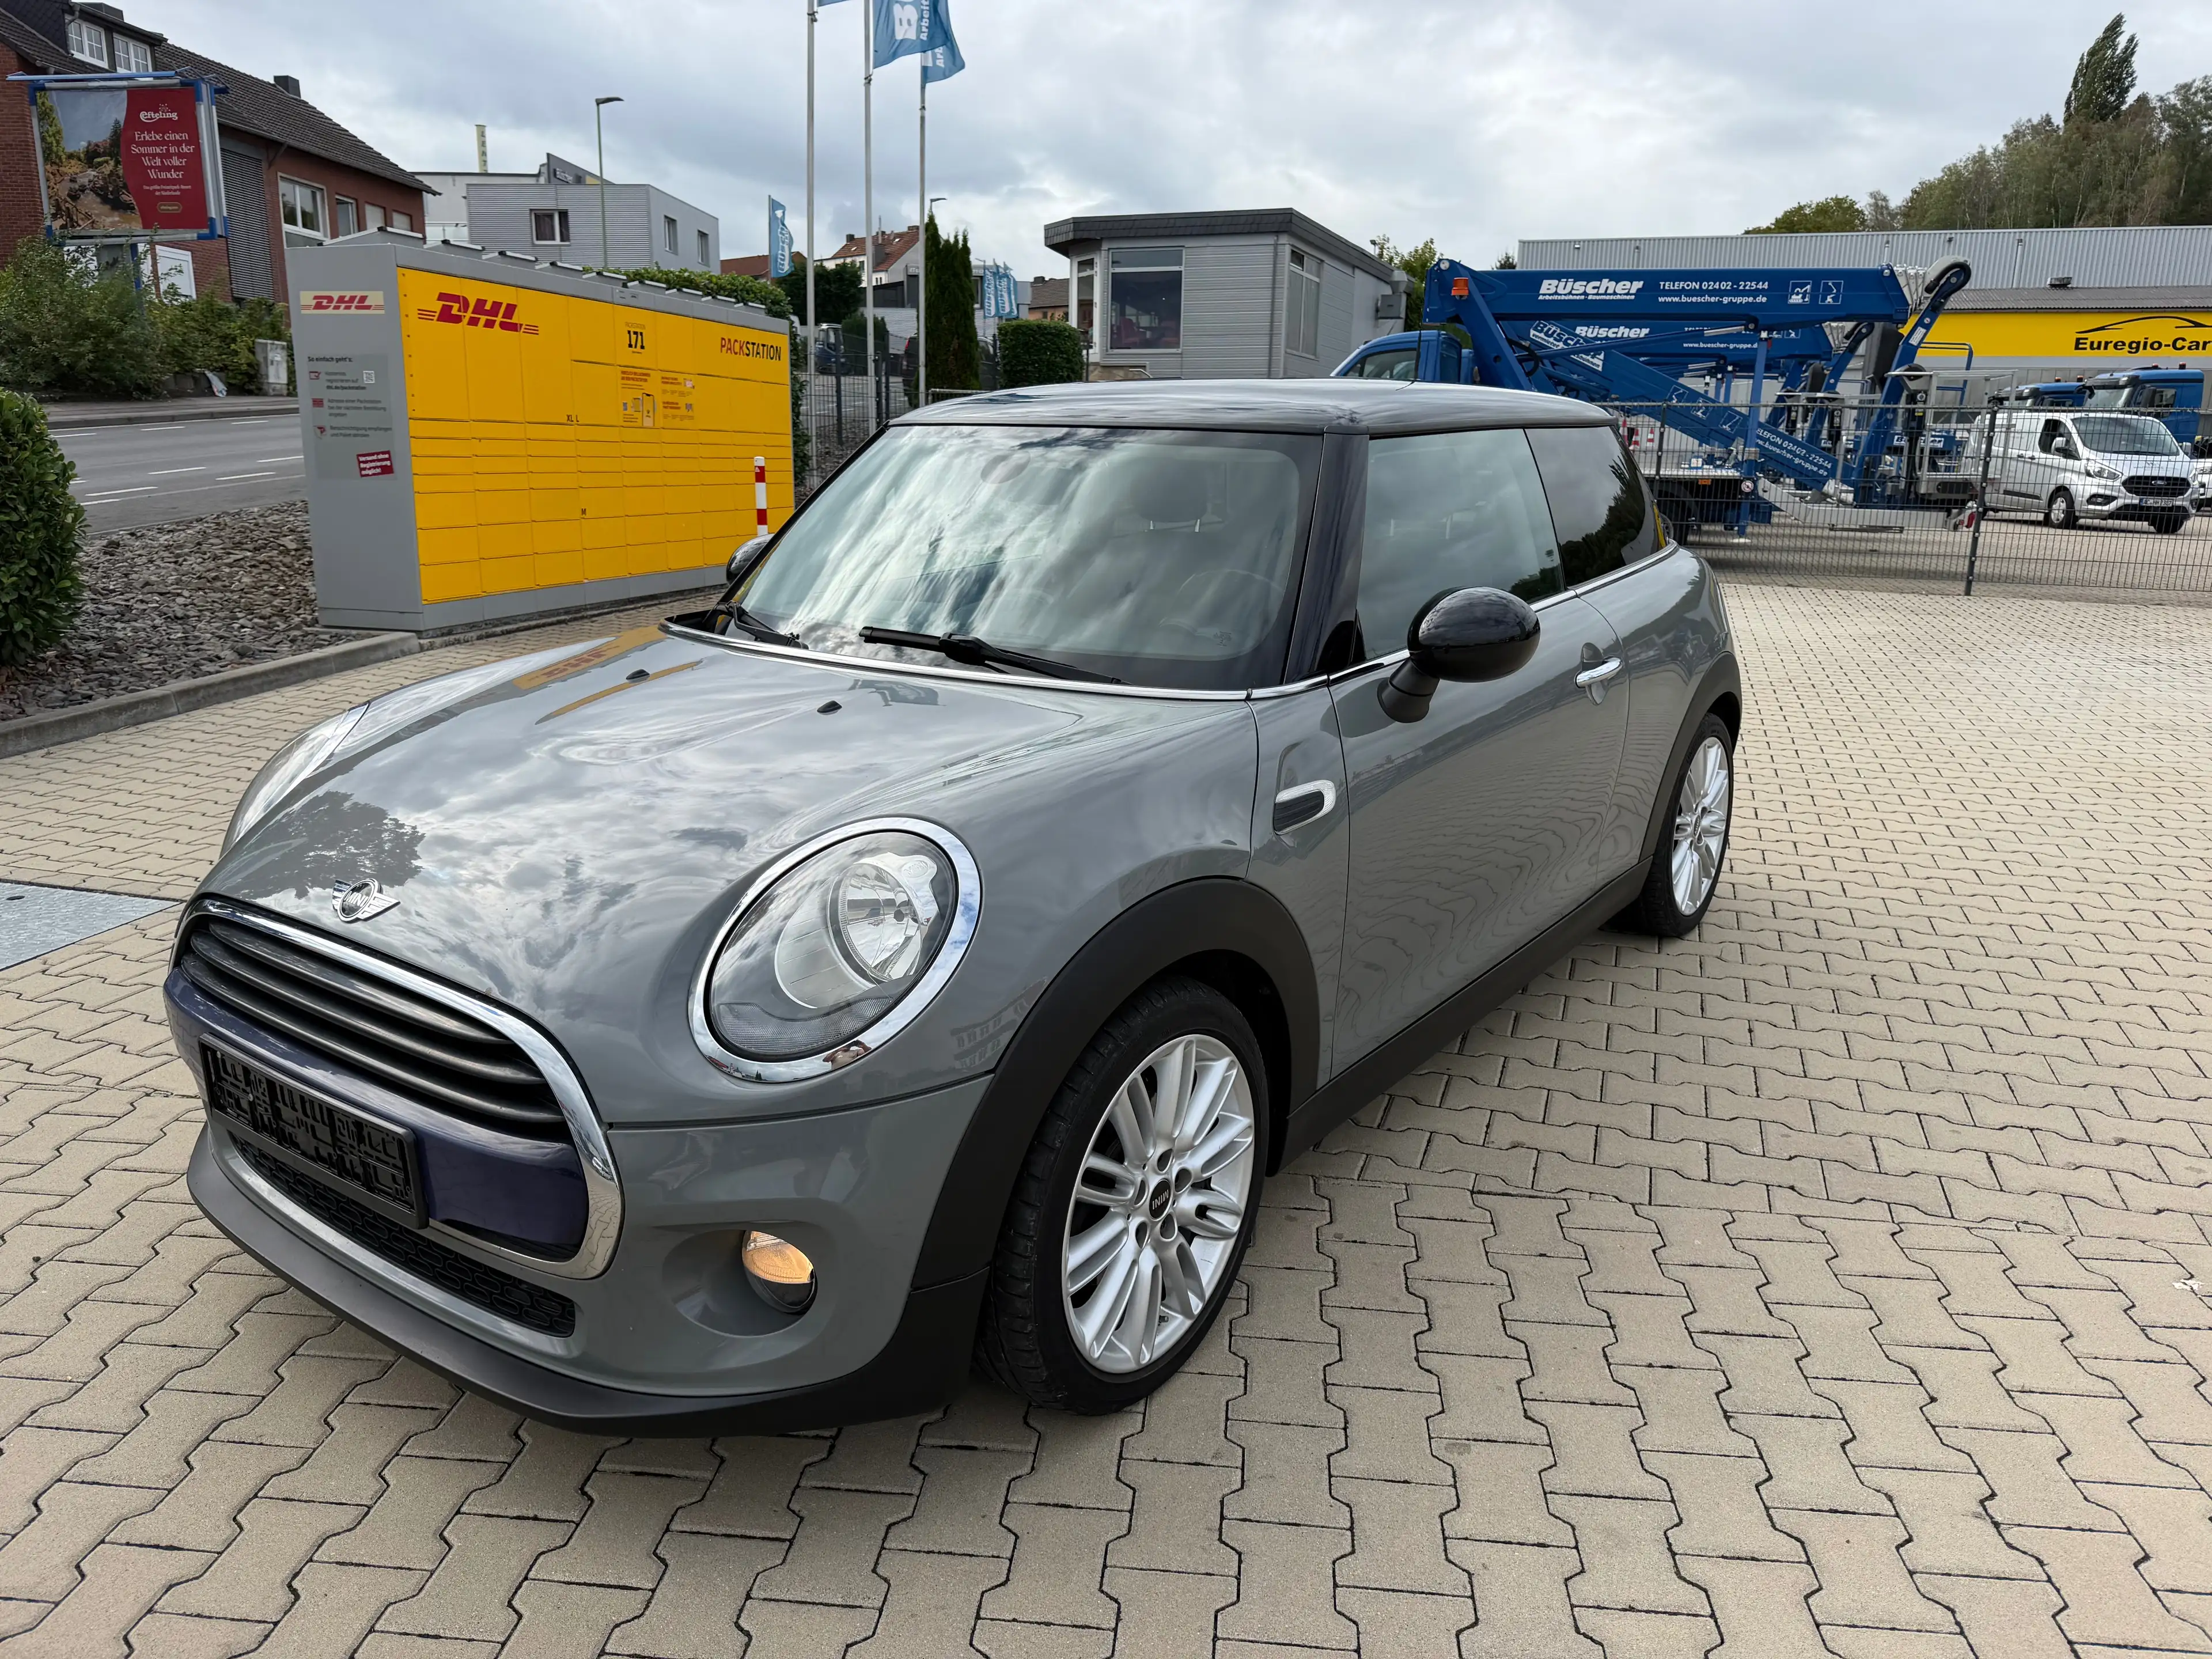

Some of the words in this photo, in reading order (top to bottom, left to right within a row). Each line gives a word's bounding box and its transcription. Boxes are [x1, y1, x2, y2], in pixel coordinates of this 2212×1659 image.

[135, 131, 163, 141] Erlebe
[164, 131, 189, 141] einen
[131, 144, 168, 154] Sommer
[169, 143, 178, 153] in
[179, 143, 195, 153] der
[141, 156, 161, 166] Welt
[162, 156, 187, 166] voller
[147, 168, 184, 179] Wunder
[1539, 278, 1645, 294] Büscher
[1659, 281, 1700, 290] TELEFON
[1702, 281, 1732, 290] 02402
[1738, 281, 1768, 290] 22544
[312, 295, 373, 310] DHL
[1658, 294, 1767, 304] www.buescher-gruppe.de
[435, 291, 524, 333] DHL
[1575, 325, 1650, 338] Büscher
[627, 330, 645, 350] 171
[2074, 337, 2212, 354] Euregio-Car
[720, 337, 781, 361] PACKSTATION
[566, 414, 574, 422] XL
[576, 414, 579, 423] L
[343, 891, 369, 907] MINI
[1152, 1188, 1169, 1210] MINI
